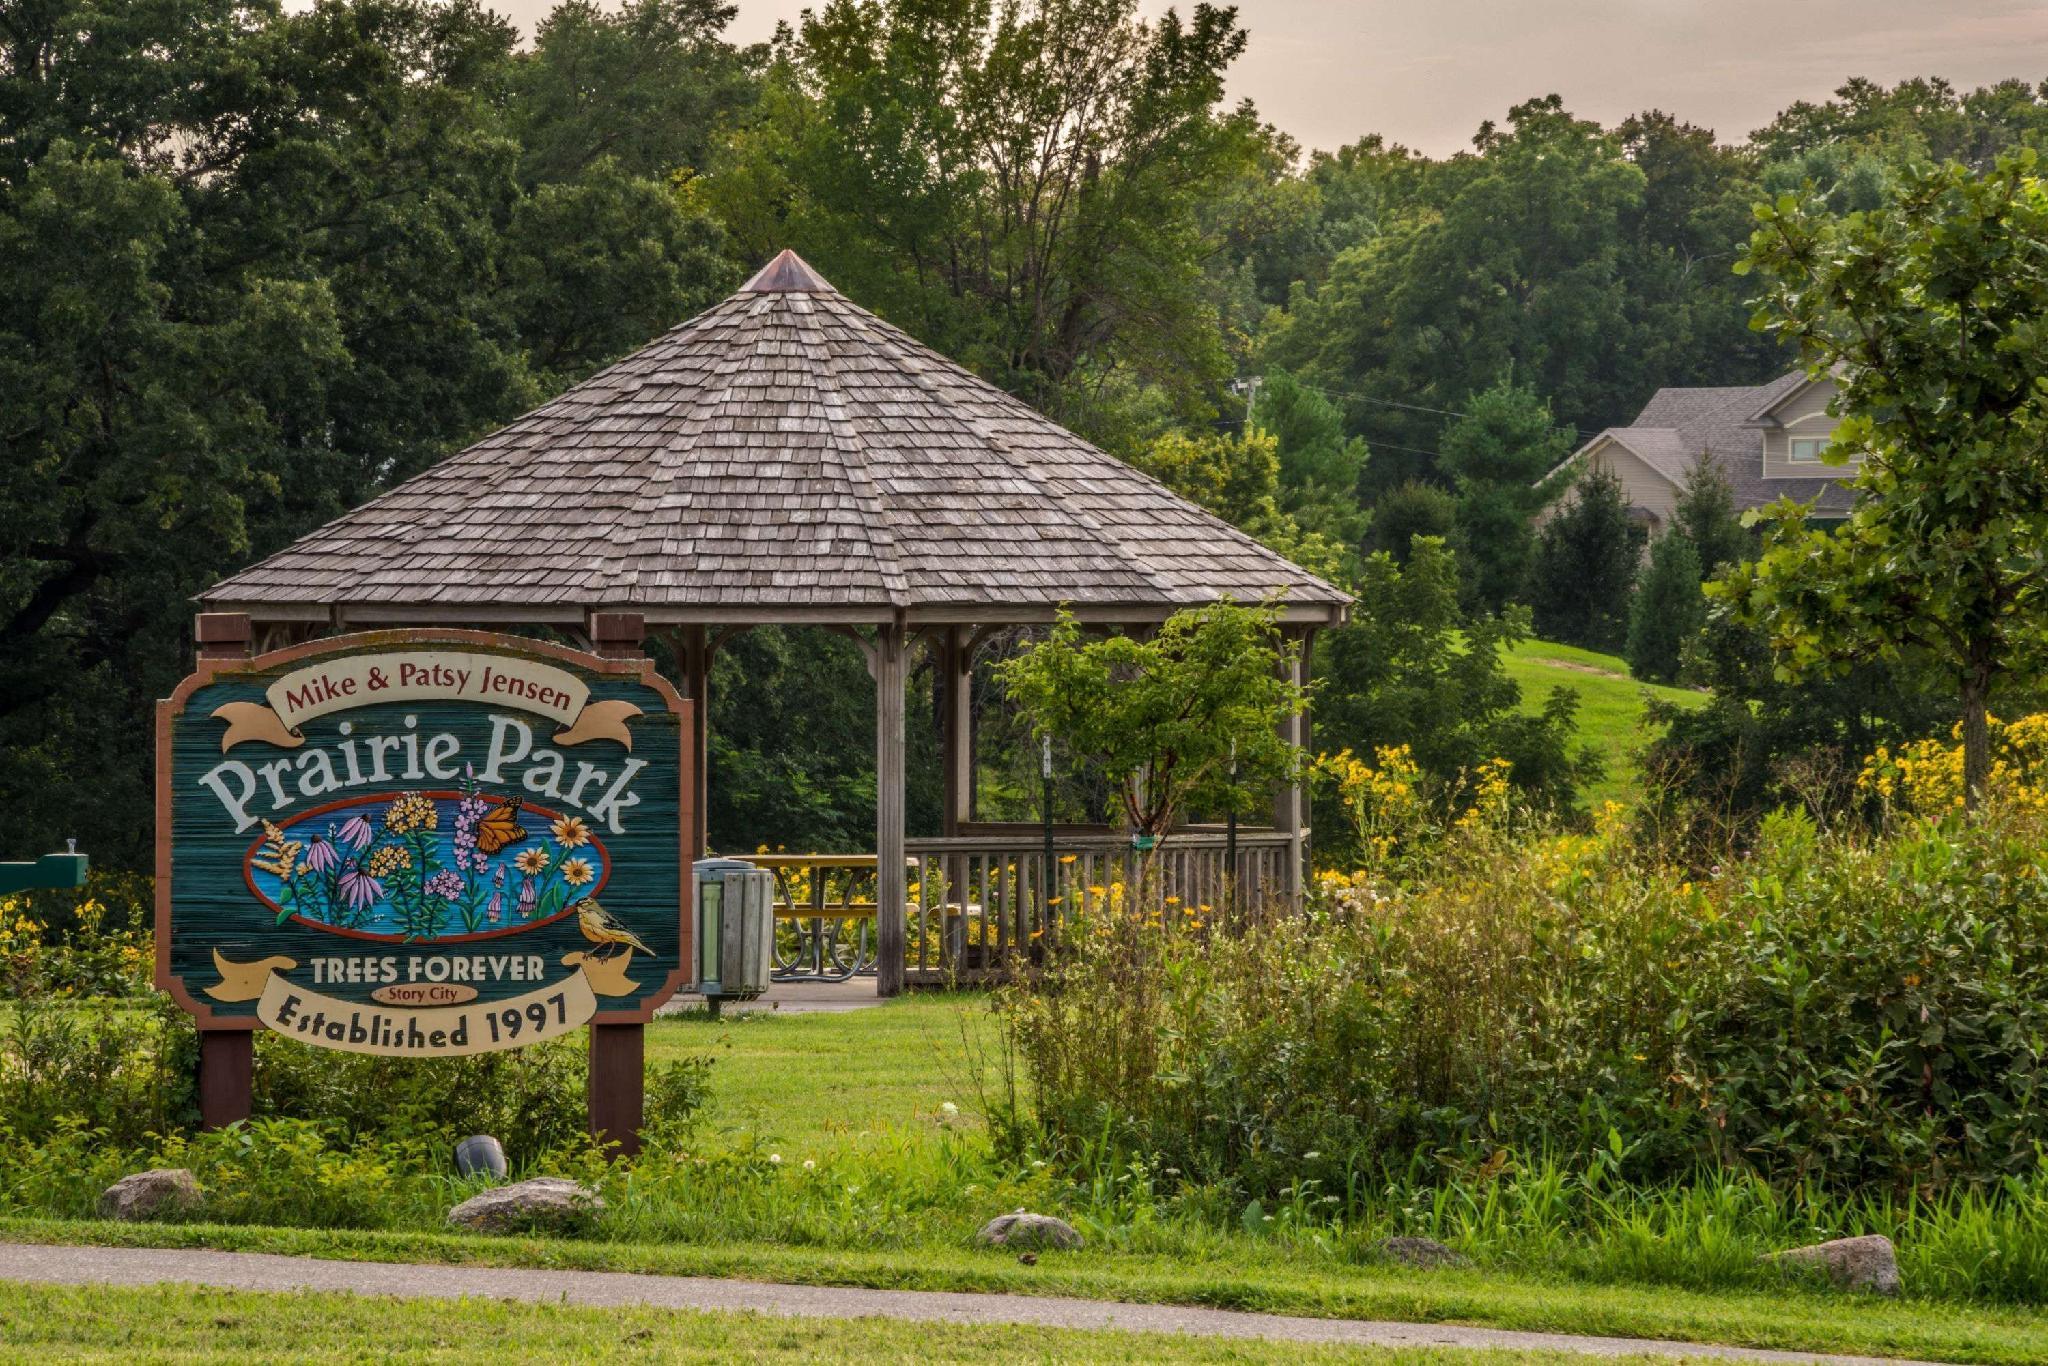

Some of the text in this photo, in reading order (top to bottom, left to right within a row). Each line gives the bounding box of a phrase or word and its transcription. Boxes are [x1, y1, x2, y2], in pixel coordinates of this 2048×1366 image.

[285, 663, 572, 714] Mike & Patsy Jensen
[199, 714, 649, 835] Prairie Park
[310, 955, 545, 983] TREES FOREVER
[388, 987, 458, 1002] Story City
[276, 993, 567, 1048] Established 1997
